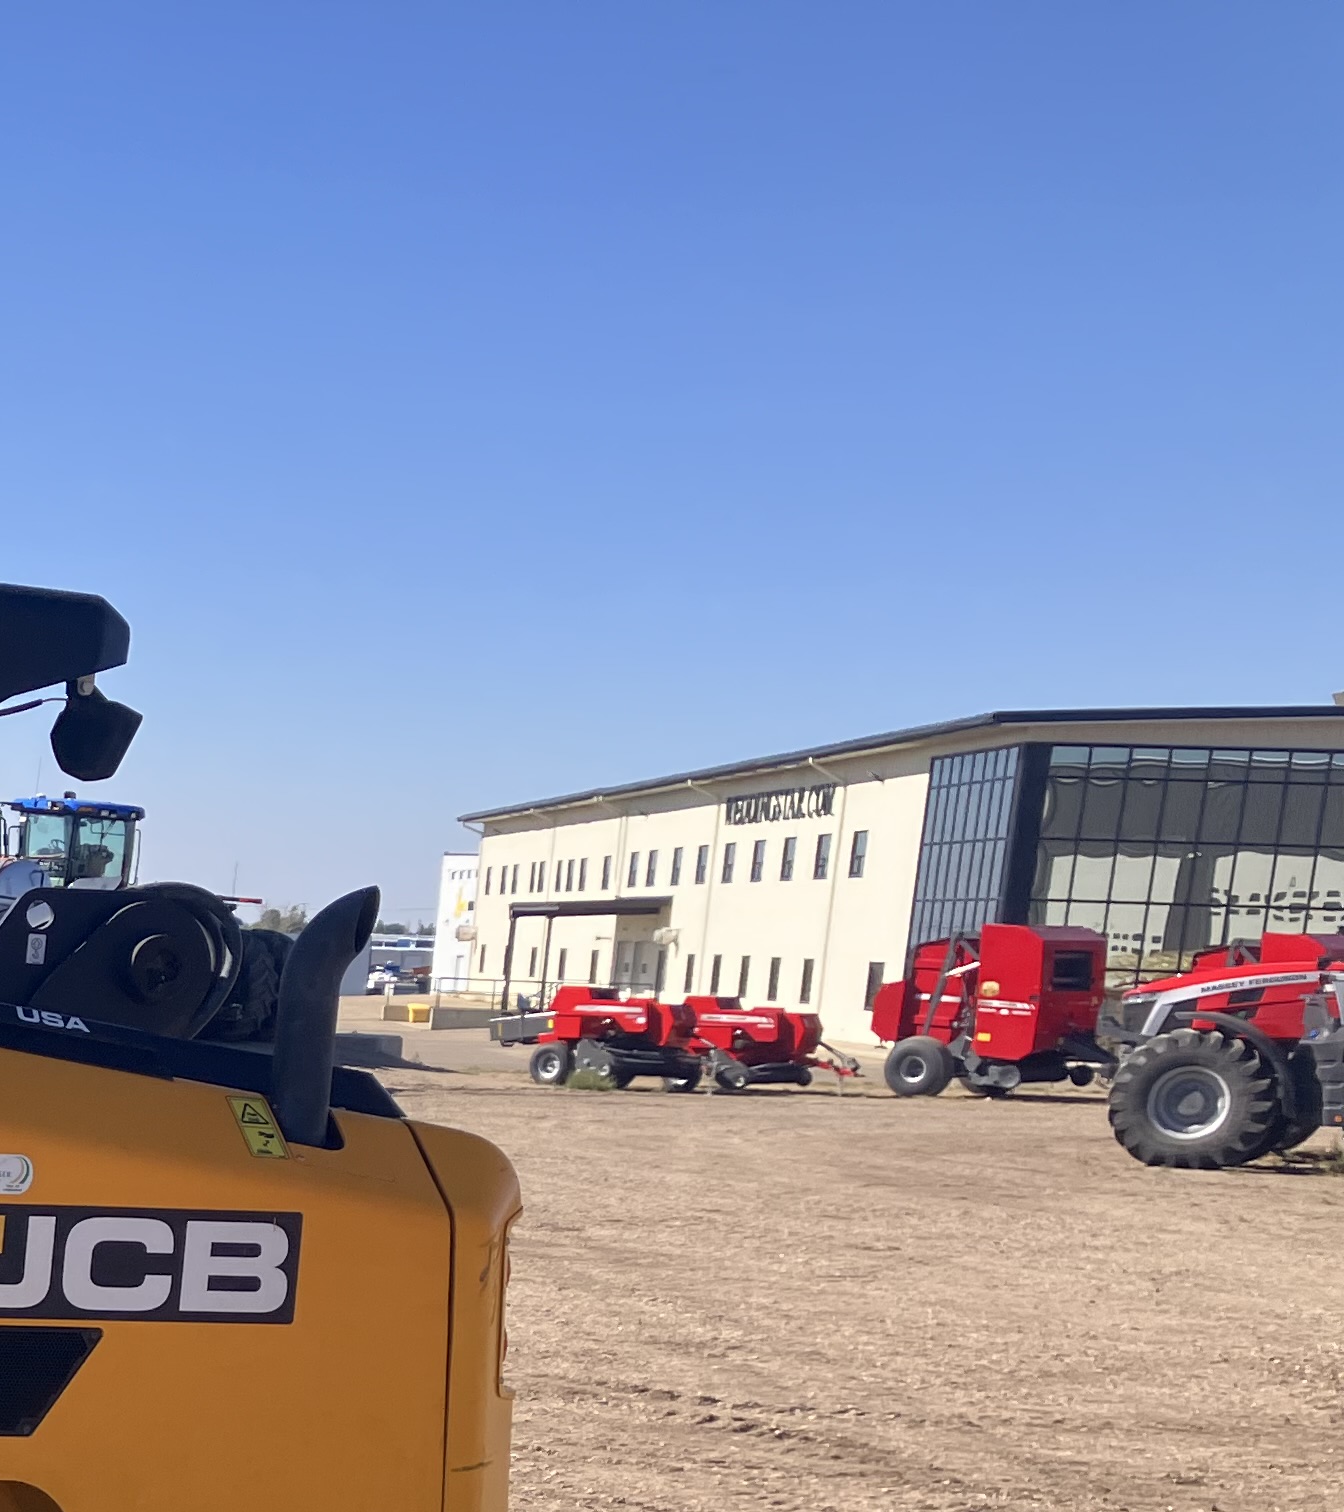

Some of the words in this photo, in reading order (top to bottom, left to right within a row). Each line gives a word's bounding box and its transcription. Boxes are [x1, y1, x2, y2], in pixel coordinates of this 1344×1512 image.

[1200, 981, 1245, 993] MASSEY
[1248, 974, 1307, 985] FERGUSON
[15, 1006, 91, 1033] USA
